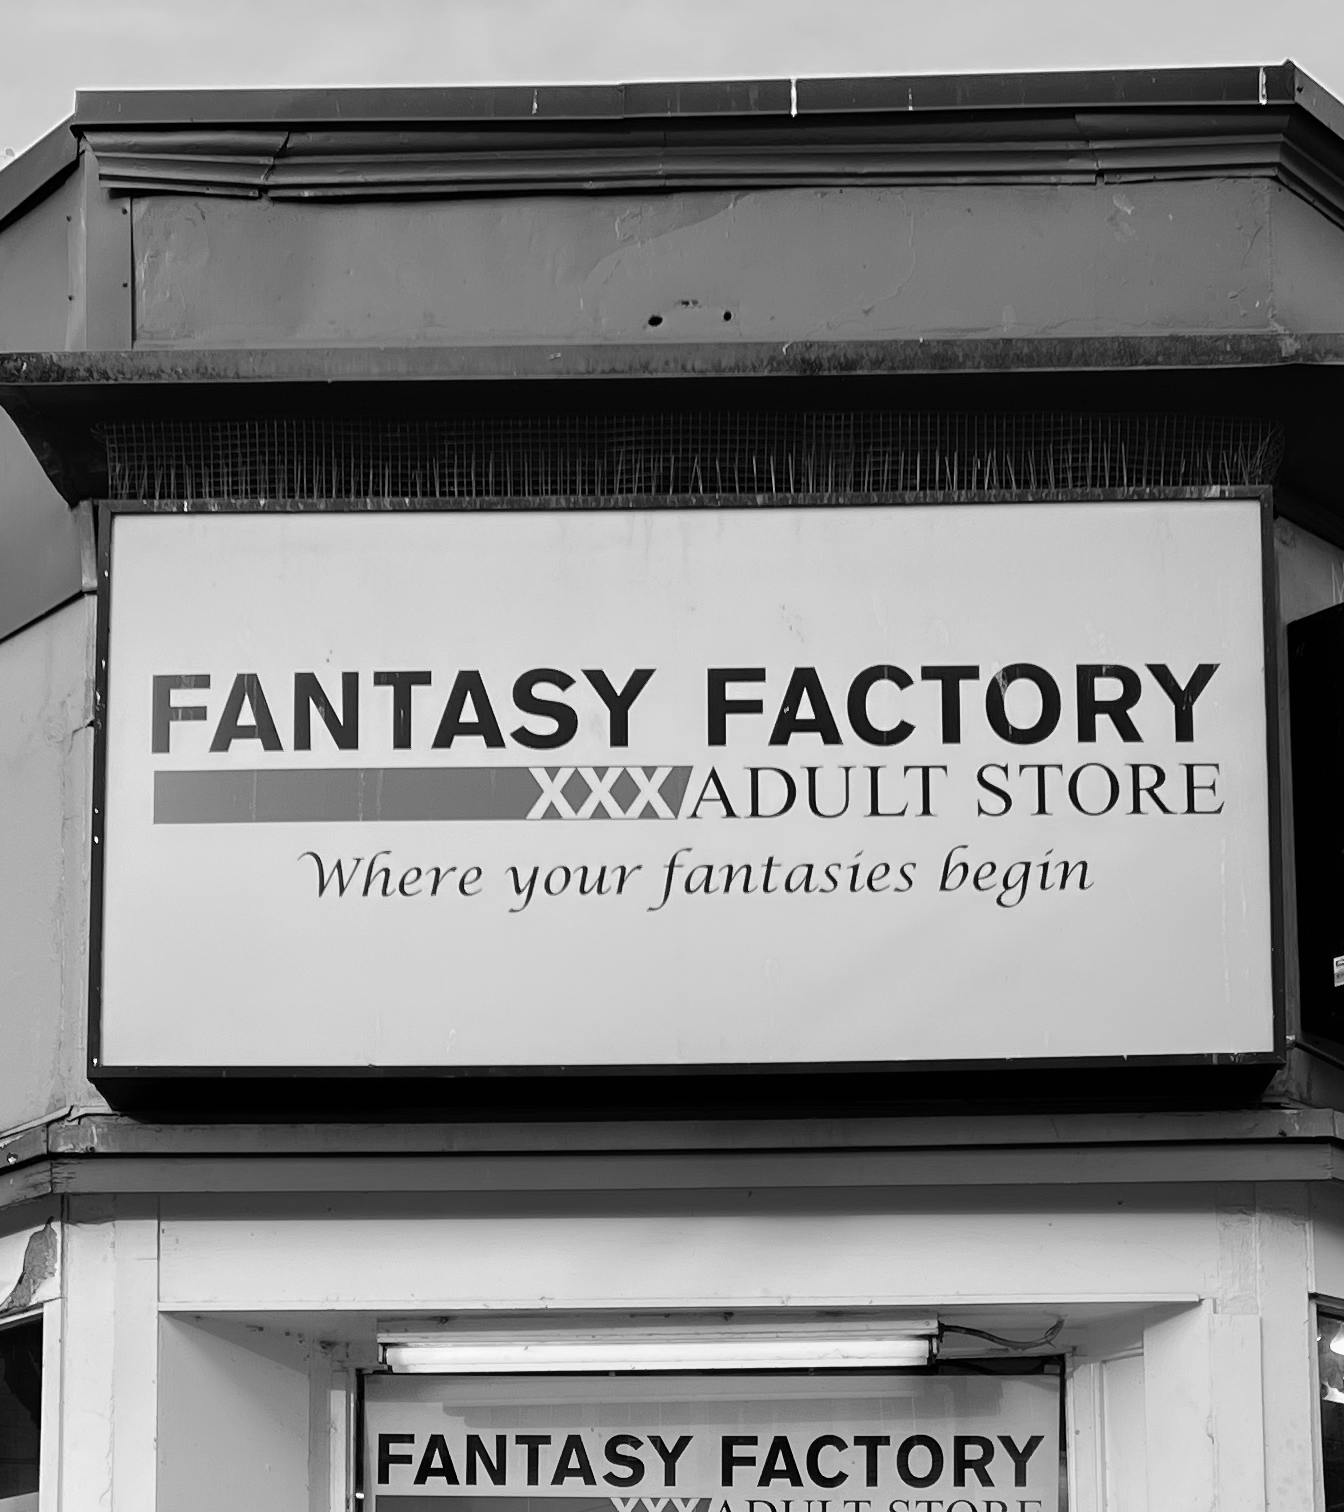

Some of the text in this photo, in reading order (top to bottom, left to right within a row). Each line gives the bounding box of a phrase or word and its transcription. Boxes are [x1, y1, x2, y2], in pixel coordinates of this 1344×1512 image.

[151, 661, 1222, 756] FANTASY FACTORY
[685, 763, 948, 821] ADULT
[976, 760, 1226, 818] STORE
[297, 844, 1095, 913] Where your fantasies begin
[377, 1433, 1045, 1489] FANTASY FACTORY
